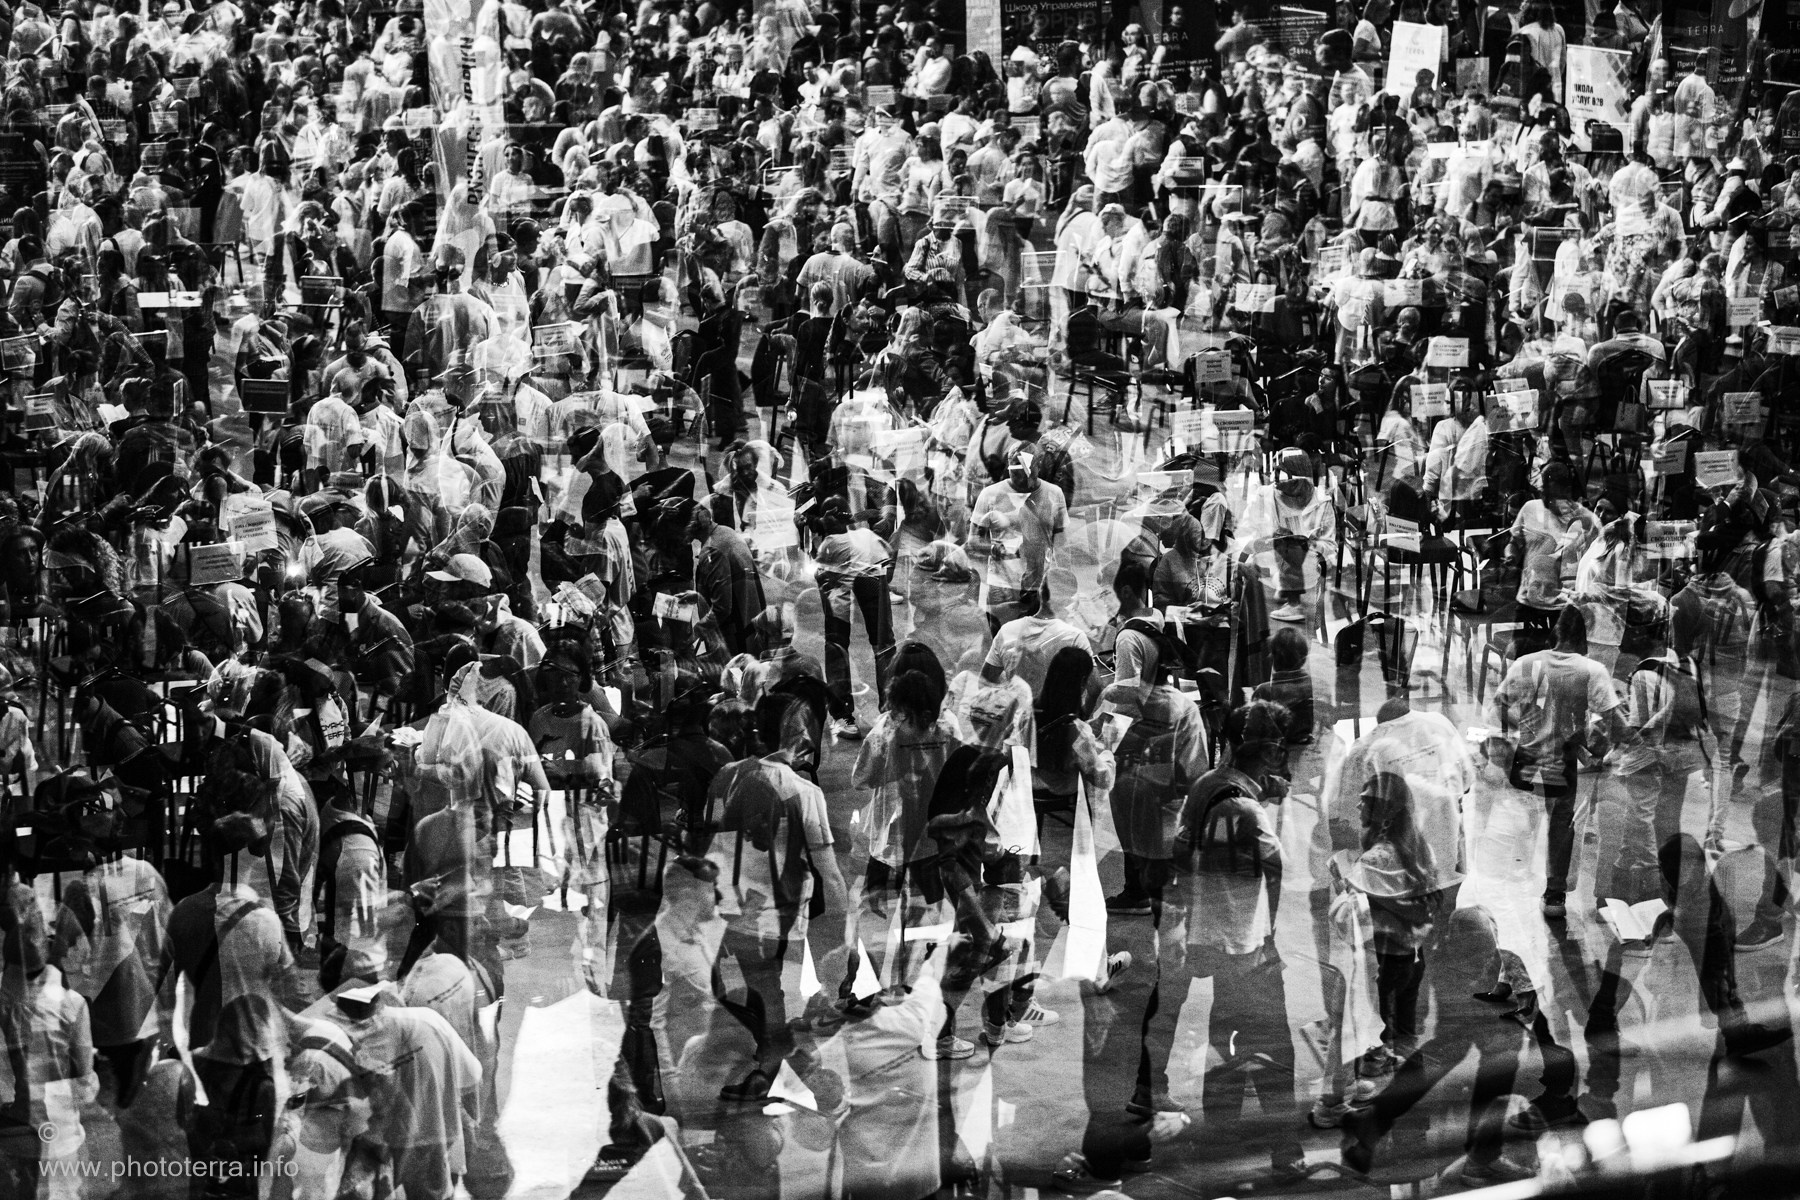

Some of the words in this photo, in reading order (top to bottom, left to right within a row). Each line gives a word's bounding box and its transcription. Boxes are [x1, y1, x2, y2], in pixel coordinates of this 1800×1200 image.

[1004, 3, 1038, 13] Школа
[1040, 1, 1098, 12] Управления
[1688, 24, 1724, 36] TERRA
[1144, 31, 1190, 43] TERRA
